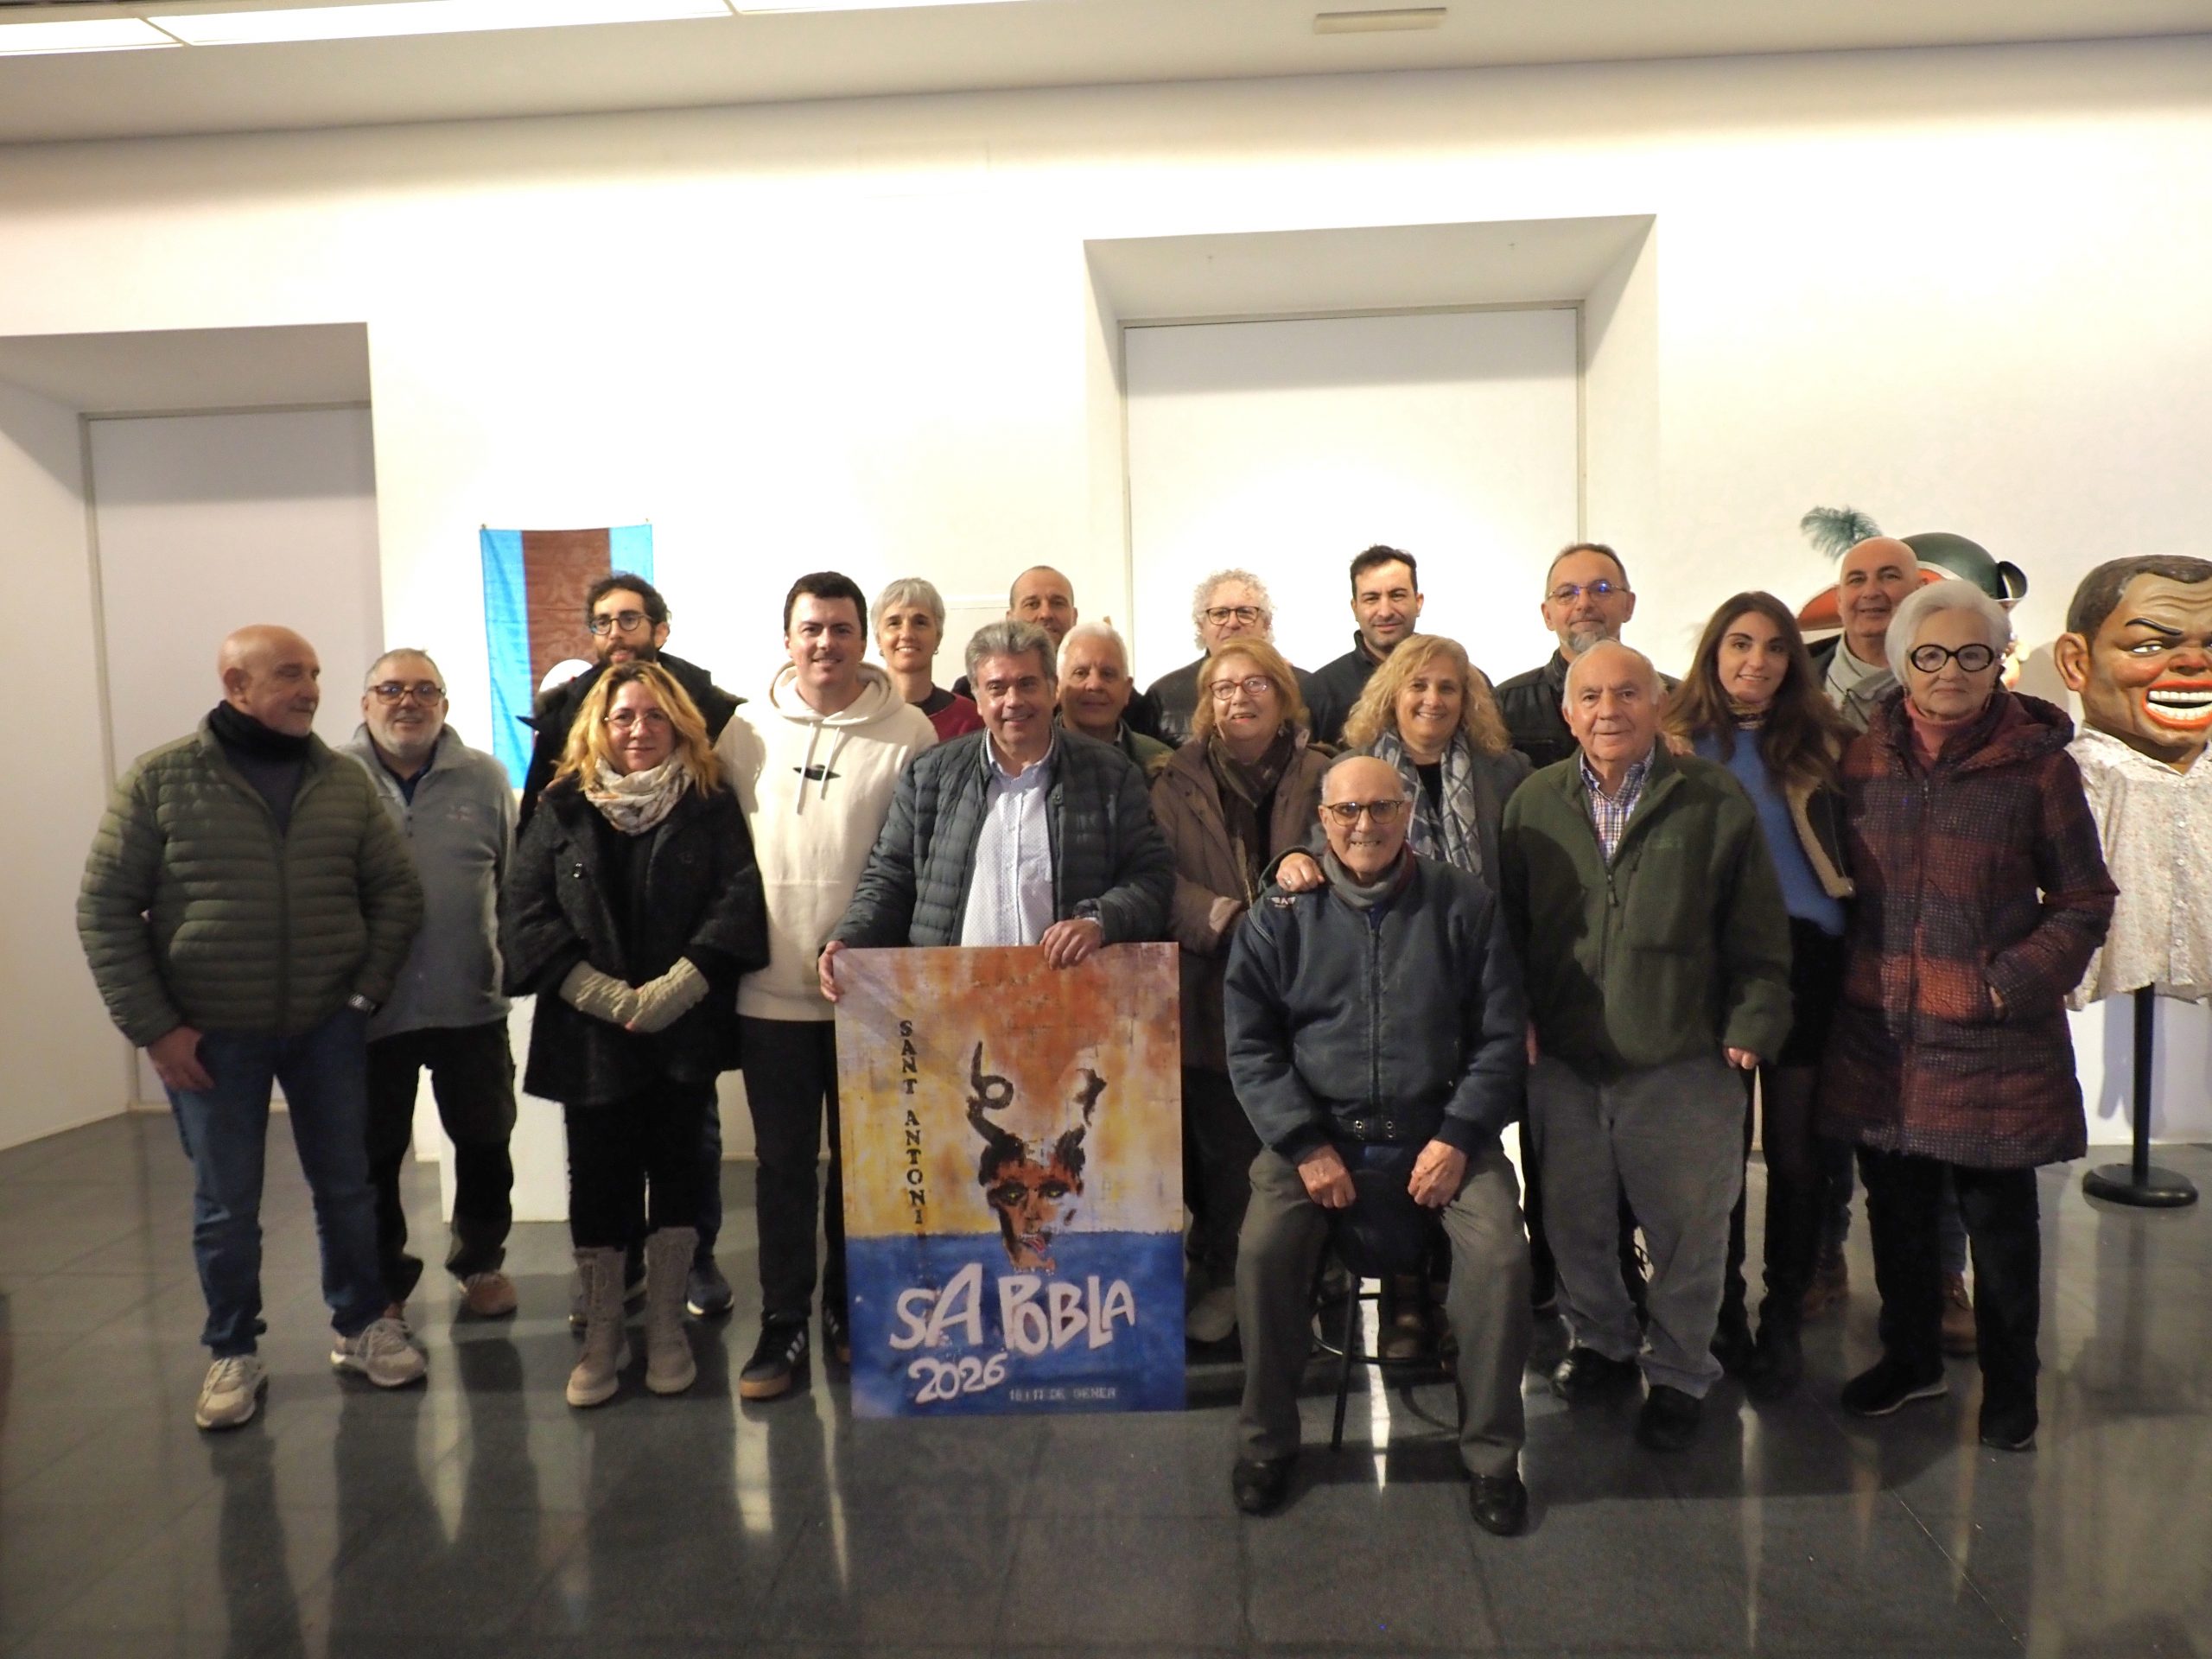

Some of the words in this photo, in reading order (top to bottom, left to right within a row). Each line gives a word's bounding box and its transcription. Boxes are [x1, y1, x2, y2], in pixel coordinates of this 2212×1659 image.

[899, 1020, 918, 1095] SANT
[905, 1109, 925, 1224] ANTONI
[889, 1262, 984, 1351] SA
[998, 1274, 1135, 1357] POBLA
[908, 1352, 1008, 1404] 2026
